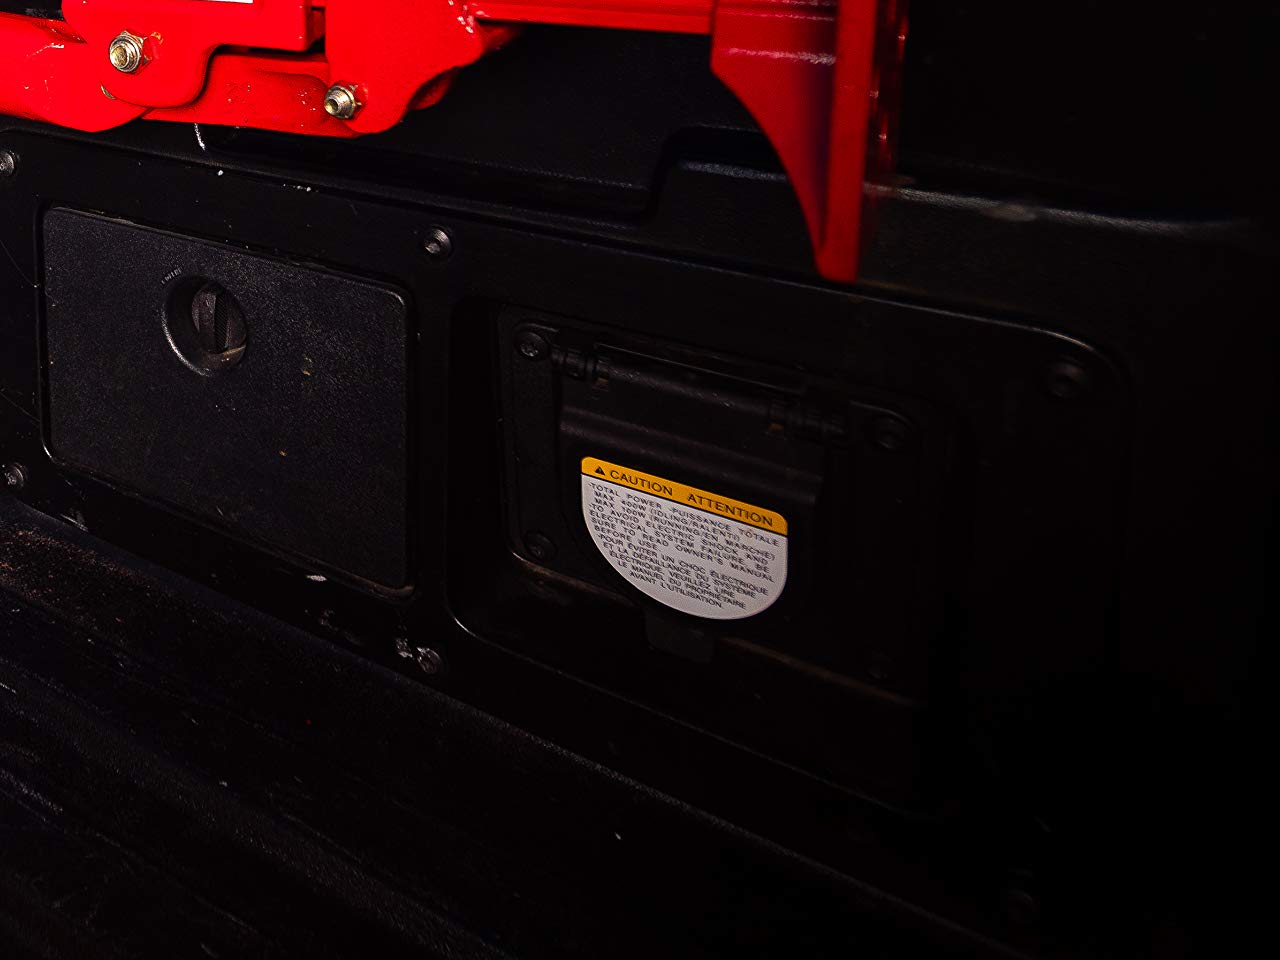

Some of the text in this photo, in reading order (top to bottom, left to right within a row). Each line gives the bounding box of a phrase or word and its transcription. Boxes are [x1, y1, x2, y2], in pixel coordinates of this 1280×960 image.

[595, 491, 615, 502] MAX
[622, 500, 646, 512] 400W
[595, 498, 615, 509] MAX
[611, 470, 773, 527] CAUTION ATTENTION
[595, 525, 632, 542] BEFORE
[627, 494, 661, 510] POWER
[738, 528, 779, 547] TOTALE
[590, 509, 648, 534] ELECTRICAL
[655, 530, 694, 549] SYSTEM
[756, 563, 770, 574] BE
[591, 517, 774, 583] SURE TO READ OWNER'S MANUAL
[611, 510, 639, 524] AVOID
[646, 520, 695, 542] ELECTRIC
[701, 538, 738, 556] SHOCK
[747, 553, 768, 566] AND
[603, 542, 613, 550] ET
[618, 546, 628, 555] LA
[696, 573, 709, 583] DU
[618, 560, 627, 569] LE
[632, 564, 665, 581] MANUEL
[669, 577, 682, 587] DU
[662, 554, 674, 564] UN
[679, 560, 706, 574] CHOC
[630, 571, 656, 585] AVANT
[669, 571, 711, 590] VEUILLEZ
[714, 586, 735, 599] LIRE
